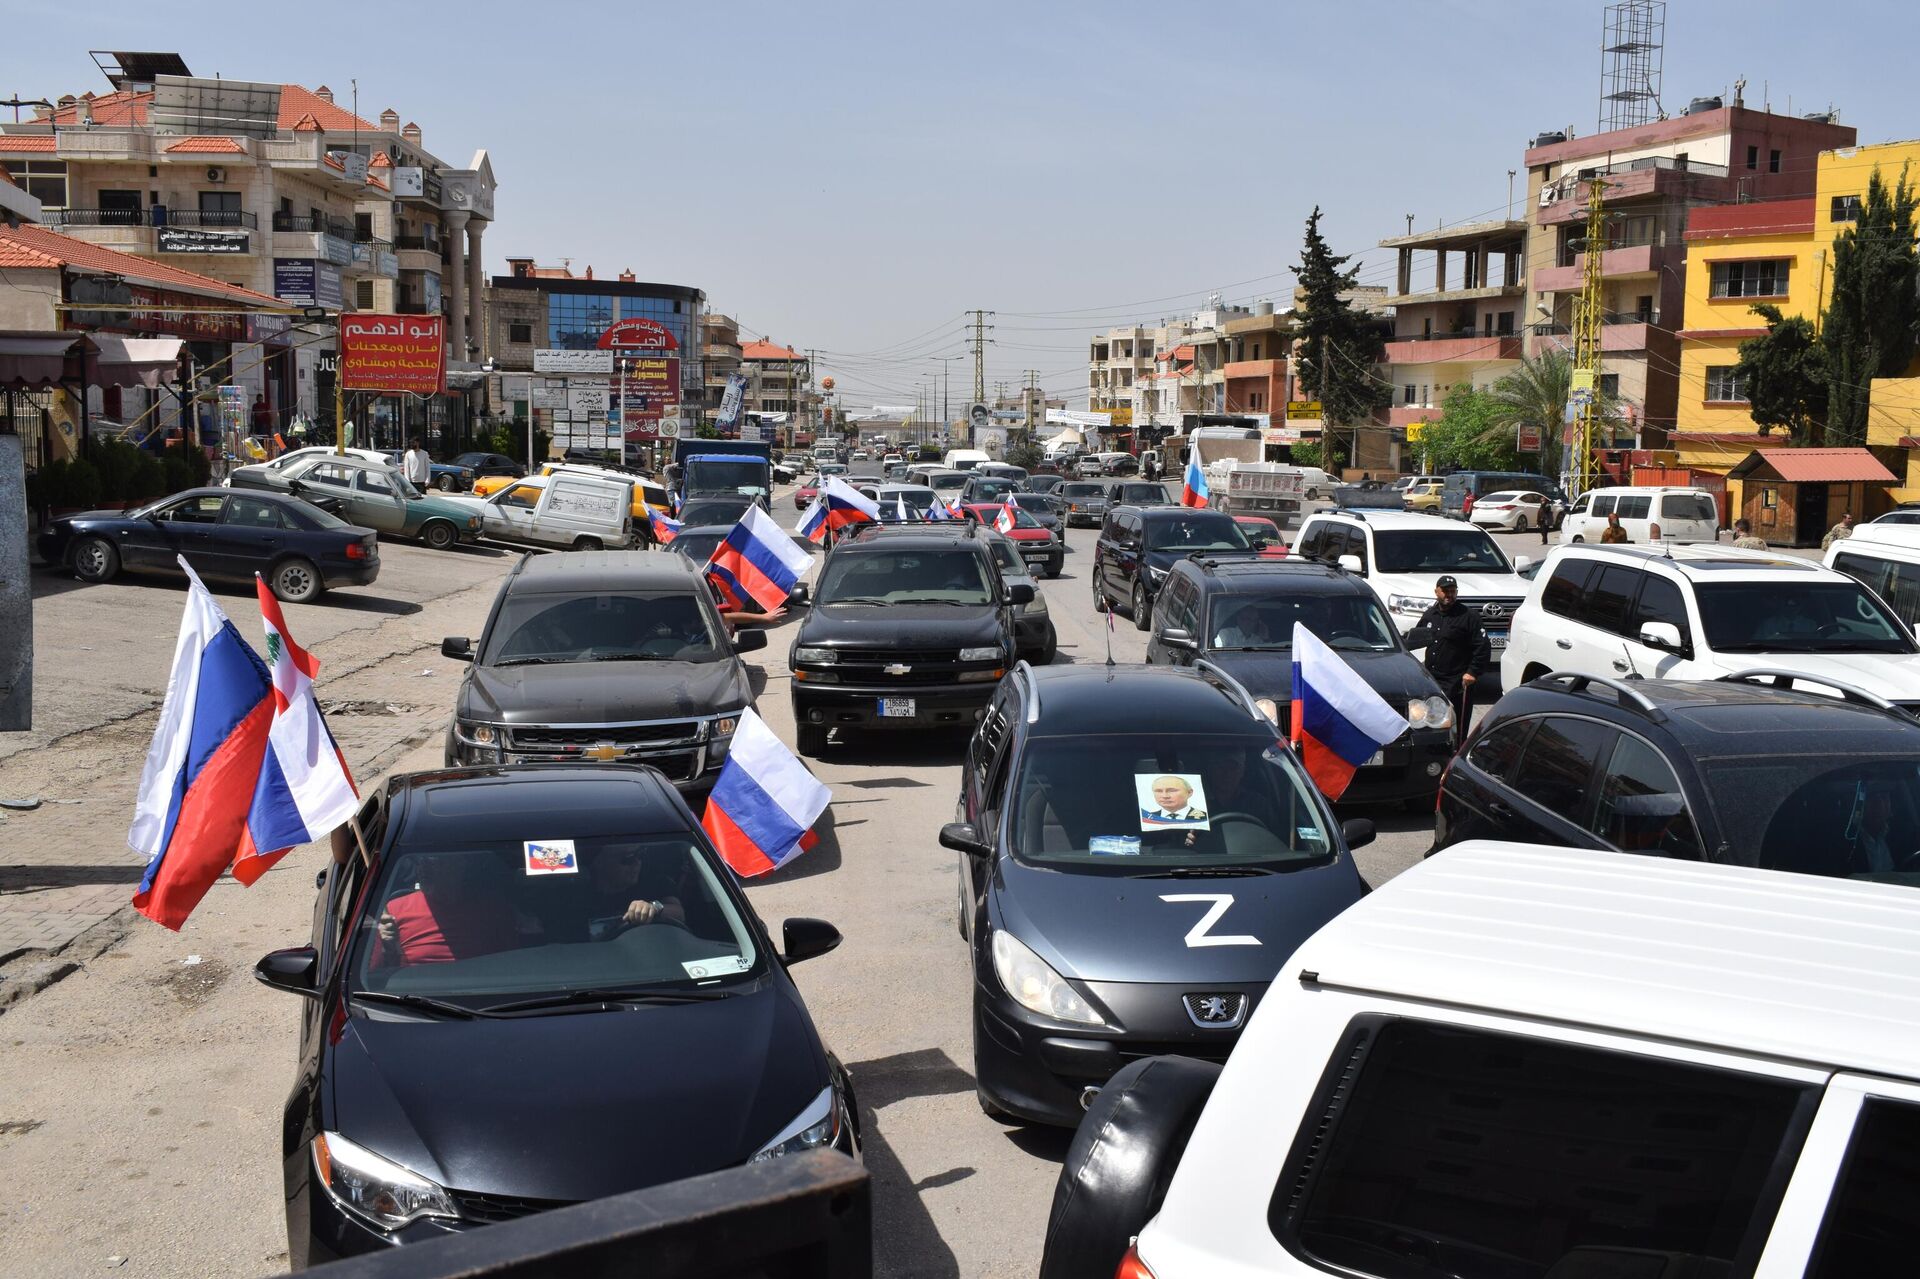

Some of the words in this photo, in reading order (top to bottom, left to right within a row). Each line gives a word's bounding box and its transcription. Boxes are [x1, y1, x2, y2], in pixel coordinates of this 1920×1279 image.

[255, 314, 284, 331] SAMSUNG
[640, 321, 665, 335] حلويات
[347, 341, 404, 354] ومعجنات
[405, 343, 438, 354] فرن
[1158, 893, 1263, 947] Z
